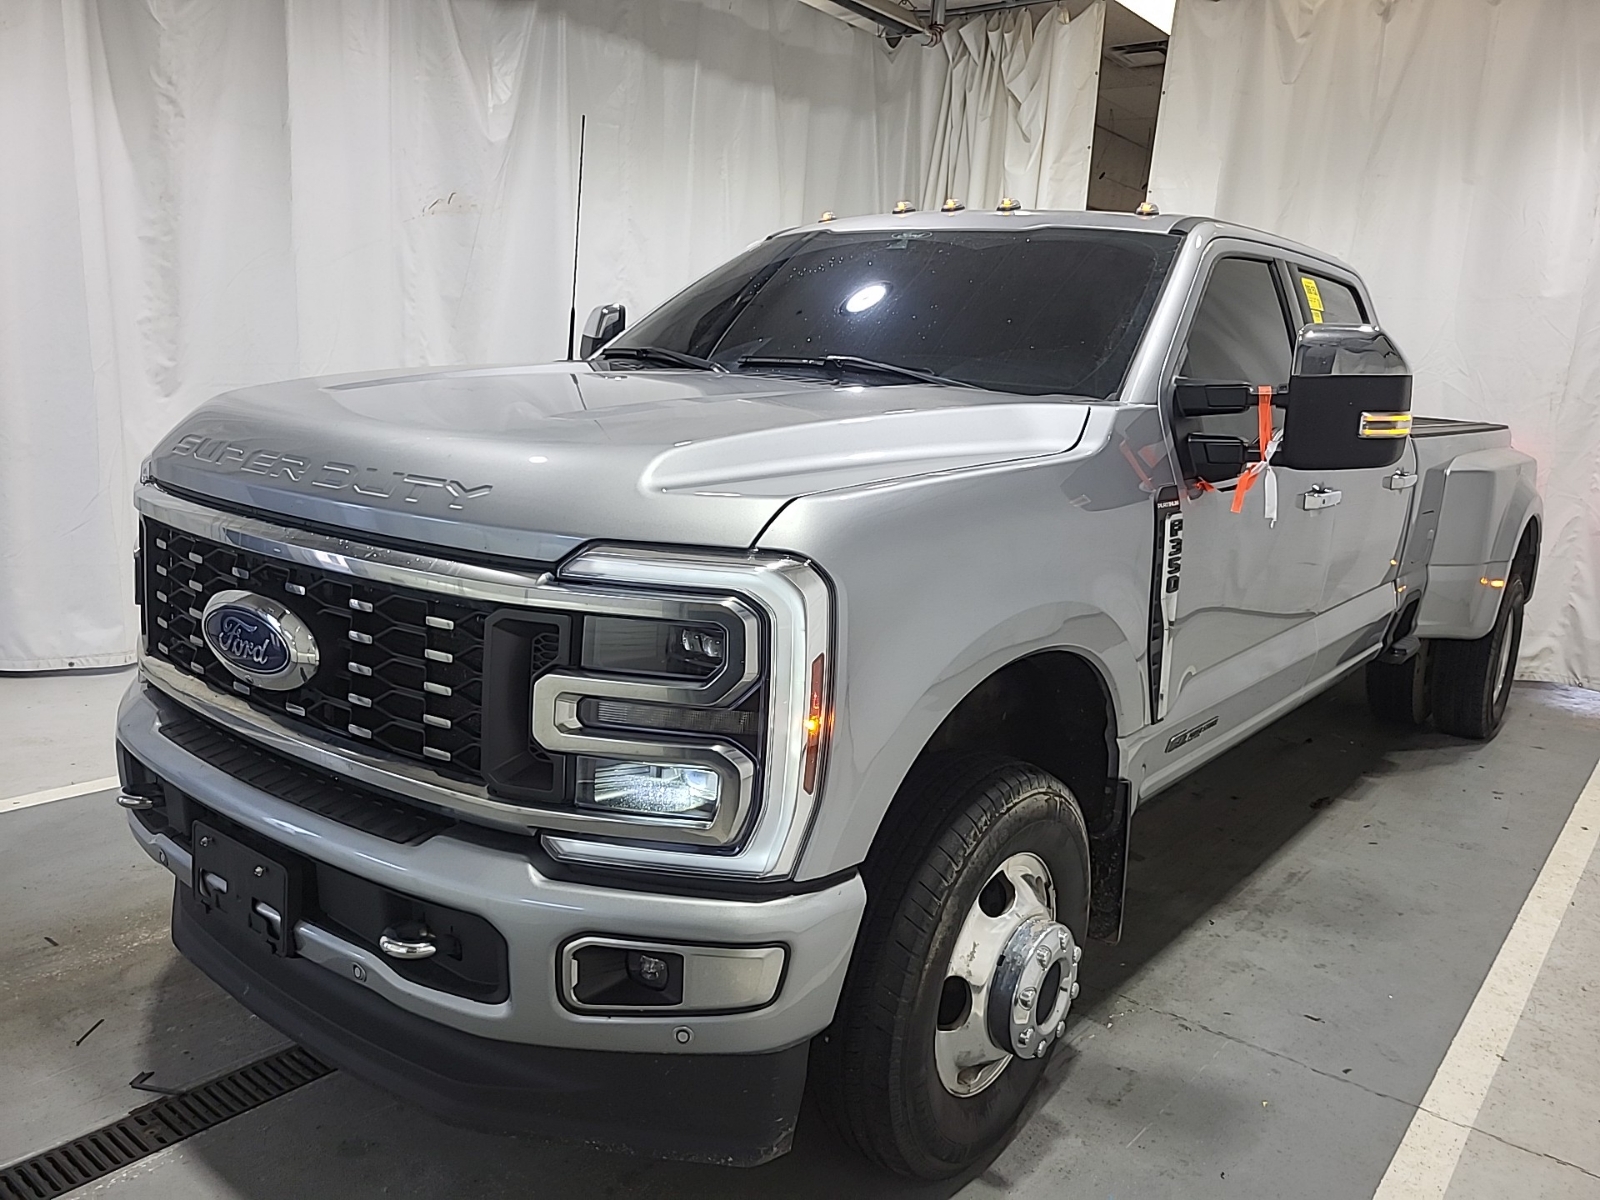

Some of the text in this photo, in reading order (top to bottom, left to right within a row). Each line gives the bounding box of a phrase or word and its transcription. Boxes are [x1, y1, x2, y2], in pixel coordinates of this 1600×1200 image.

[171, 433, 494, 510] SUPER DUTY
[219, 616, 270, 665] Ford
